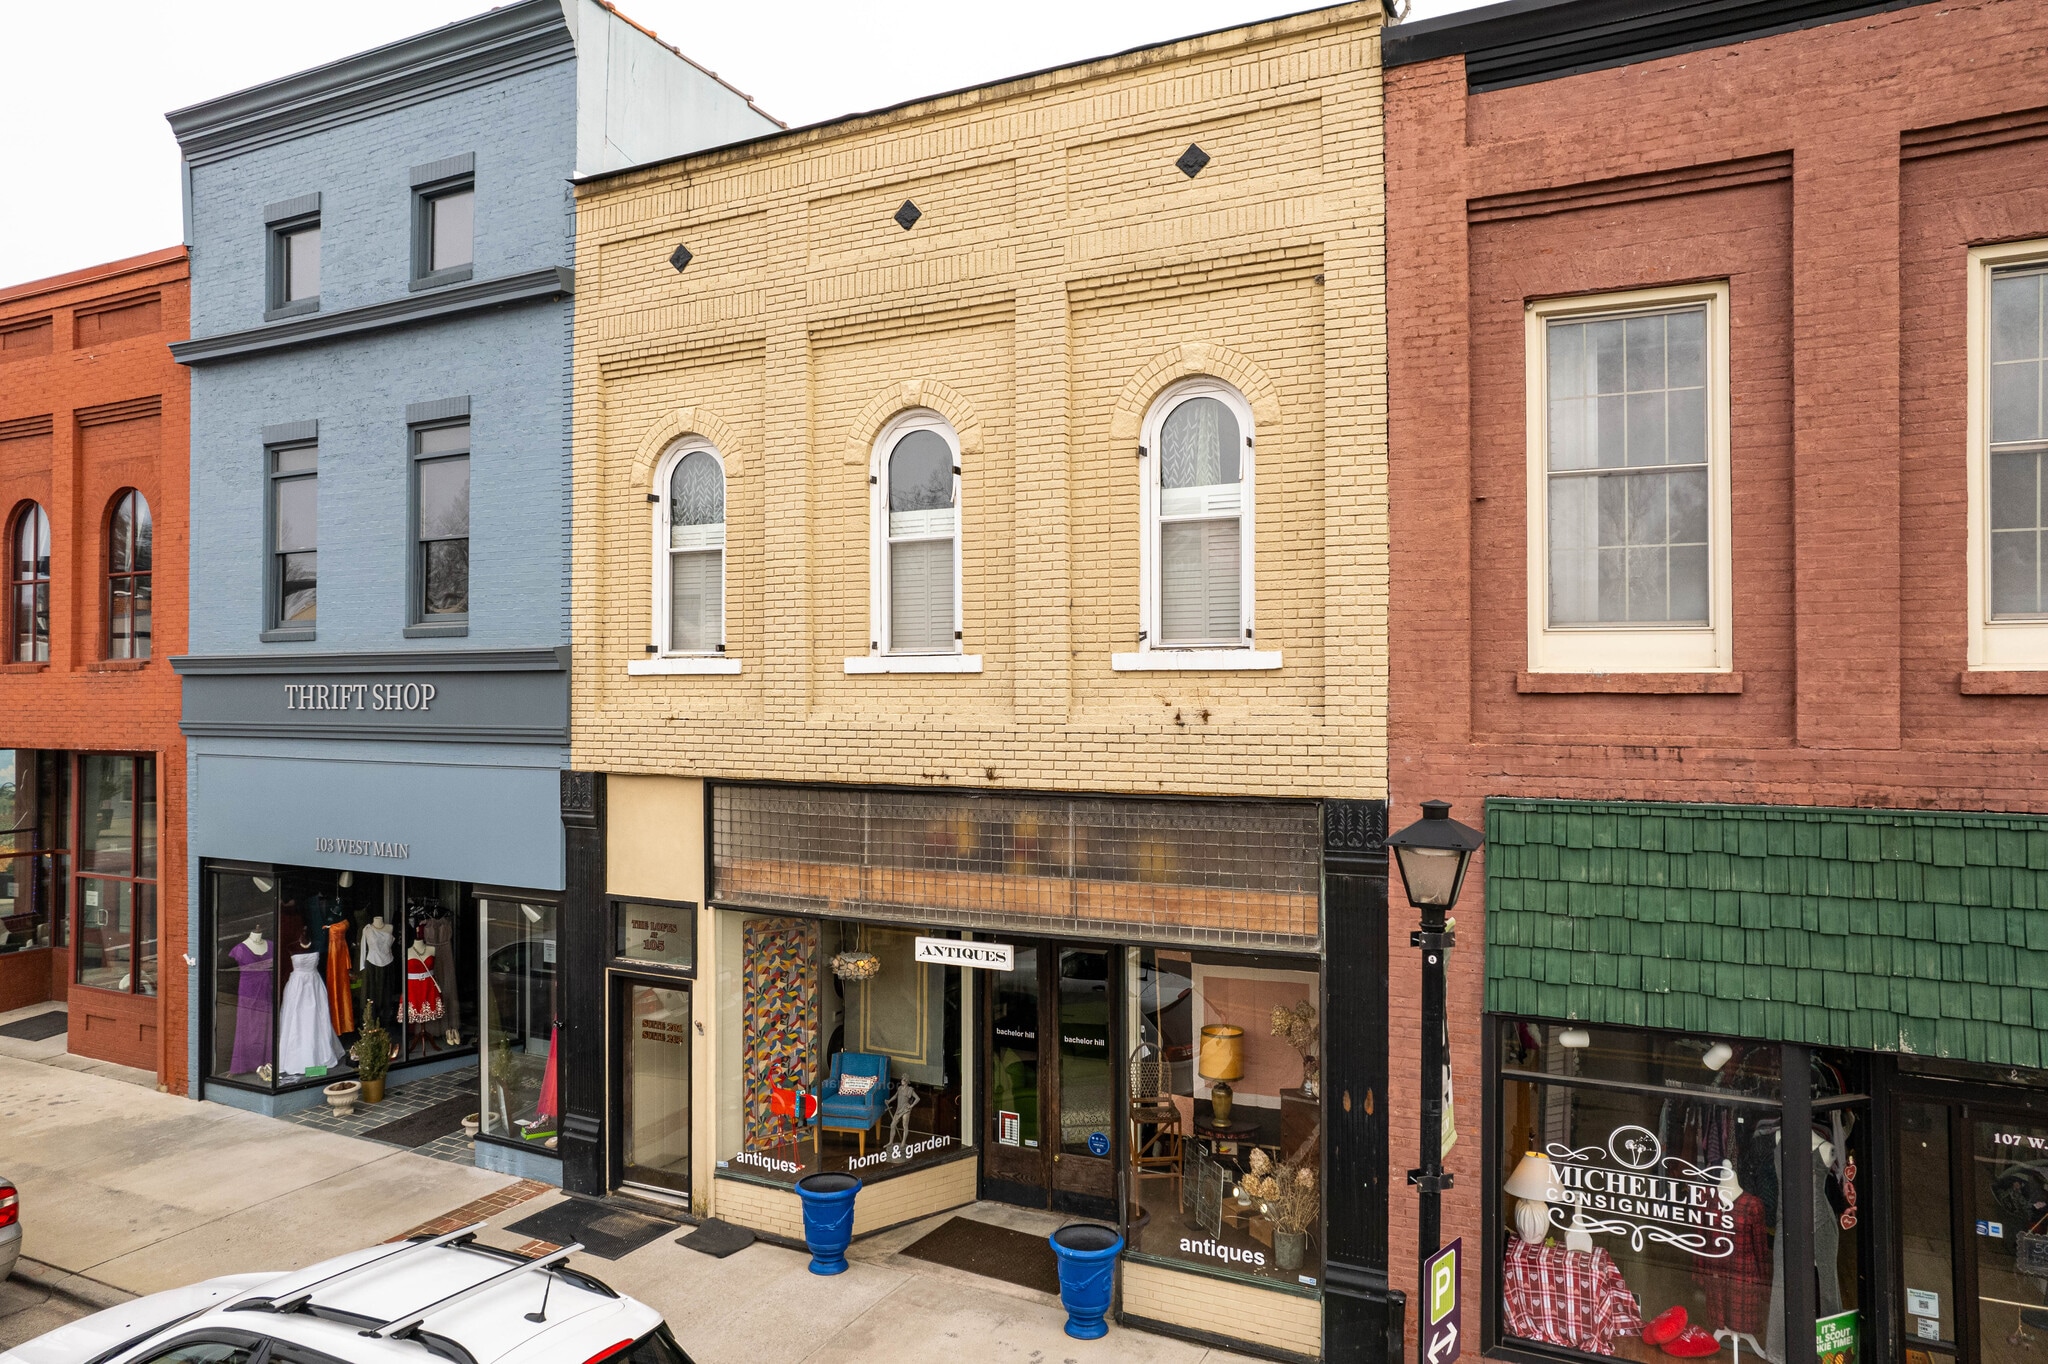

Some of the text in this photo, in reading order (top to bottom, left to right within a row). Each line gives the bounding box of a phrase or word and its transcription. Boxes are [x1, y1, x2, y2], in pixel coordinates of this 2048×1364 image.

[284, 683, 436, 711] THRIFT SHOP
[315, 837, 409, 859] 103 WEST MAIN
[631, 919, 677, 934] THE LOFTS
[643, 939, 665, 951] 105
[919, 945, 1007, 963] ANTIQUES
[642, 1019, 666, 1031] SUITE
[642, 1030, 666, 1042] SUITE
[996, 1027, 1035, 1039] bachelor hill
[1064, 1035, 1105, 1046] bachelor hill
[1993, 1132, 2022, 1146] 107
[849, 1134, 950, 1171] home & garden
[736, 1150, 798, 1174] antiques
[1547, 1164, 1735, 1212] MICHELLE'S
[1545, 1187, 1735, 1230] CONSIGNMENTS
[1180, 1238, 1265, 1266] antiques
[1435, 1266, 1451, 1311] P
[1821, 1322, 1836, 1335] IT'S
[1825, 1327, 1851, 1342] SCOUT
[1832, 1335, 1854, 1349] TIME!
